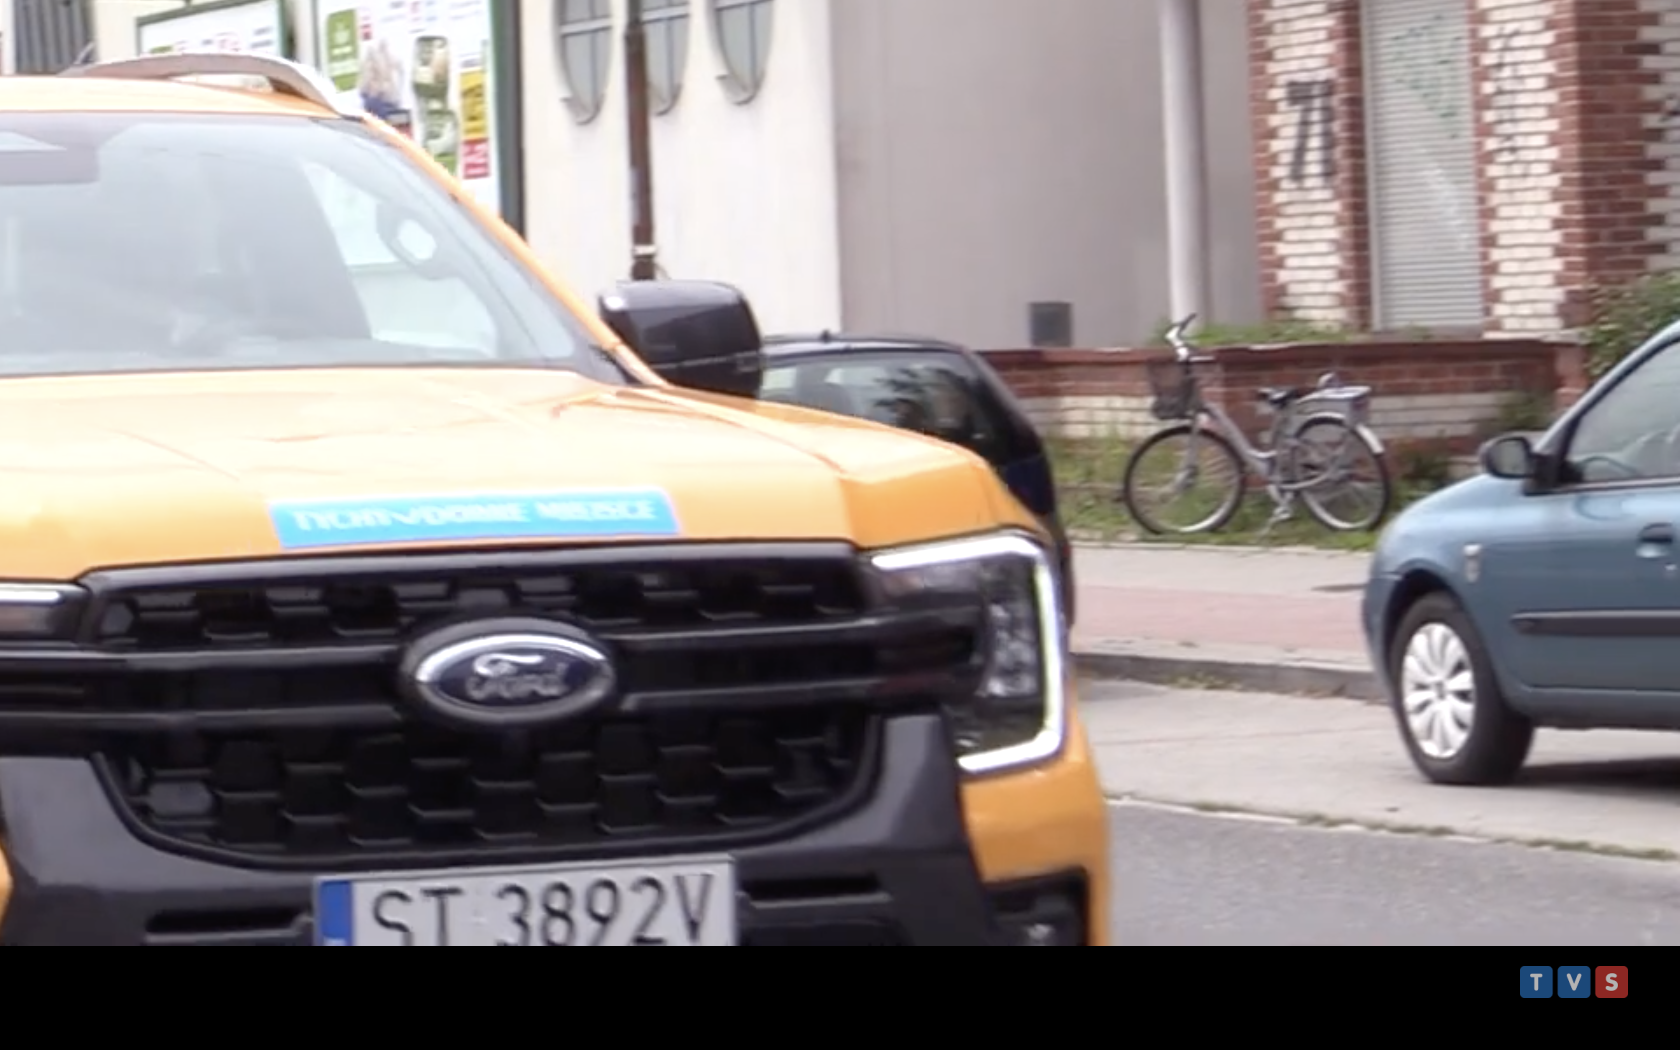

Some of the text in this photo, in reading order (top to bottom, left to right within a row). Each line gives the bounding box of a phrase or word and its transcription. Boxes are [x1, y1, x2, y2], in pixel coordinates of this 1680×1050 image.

[465, 652, 569, 700] Ford
[372, 872, 716, 946] ST 3892V
